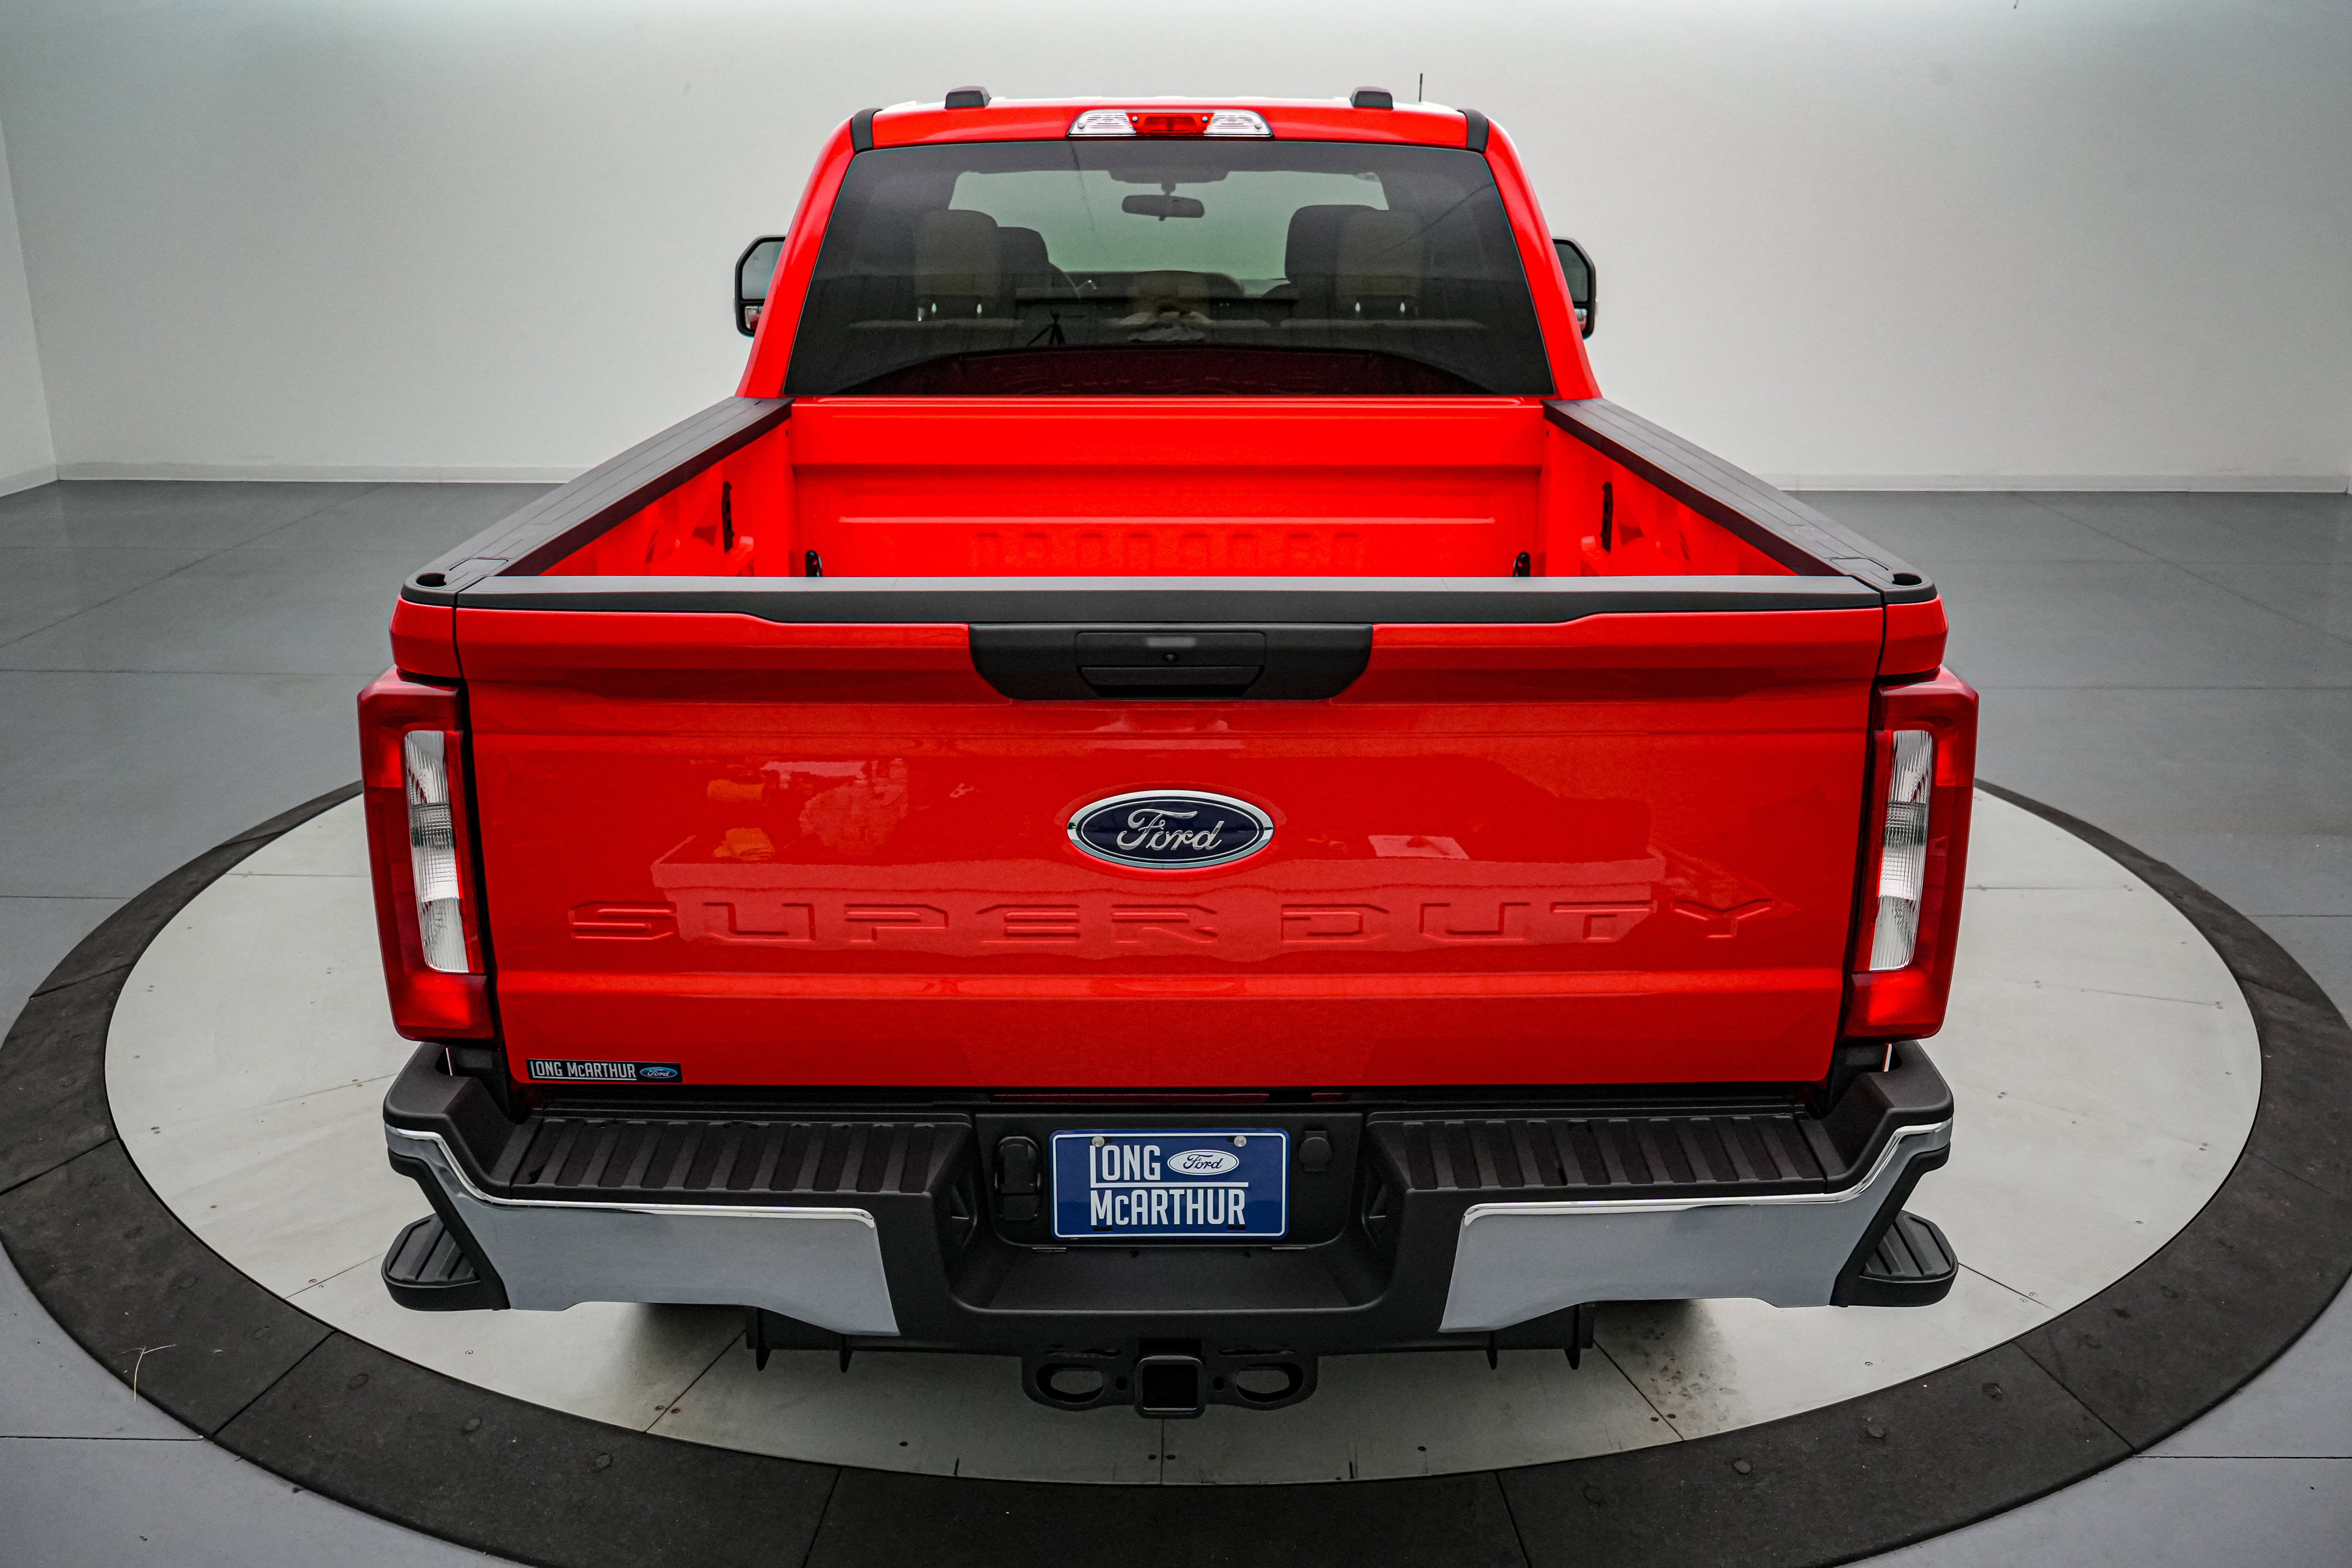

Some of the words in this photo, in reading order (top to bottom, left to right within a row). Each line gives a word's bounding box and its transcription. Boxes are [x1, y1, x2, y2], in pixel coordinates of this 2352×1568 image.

[1116, 808, 1225, 851] Ford
[568, 901, 1218, 944] SUPER
[1279, 898, 1774, 943] DUTY
[530, 1061, 563, 1078] LONG
[567, 1062, 636, 1078] McARTHUR
[647, 1067, 670, 1077] Ford
[1089, 1145, 1161, 1184] LONG
[1183, 1154, 1223, 1170] Ford
[1090, 1189, 1246, 1226] McARTHUR
